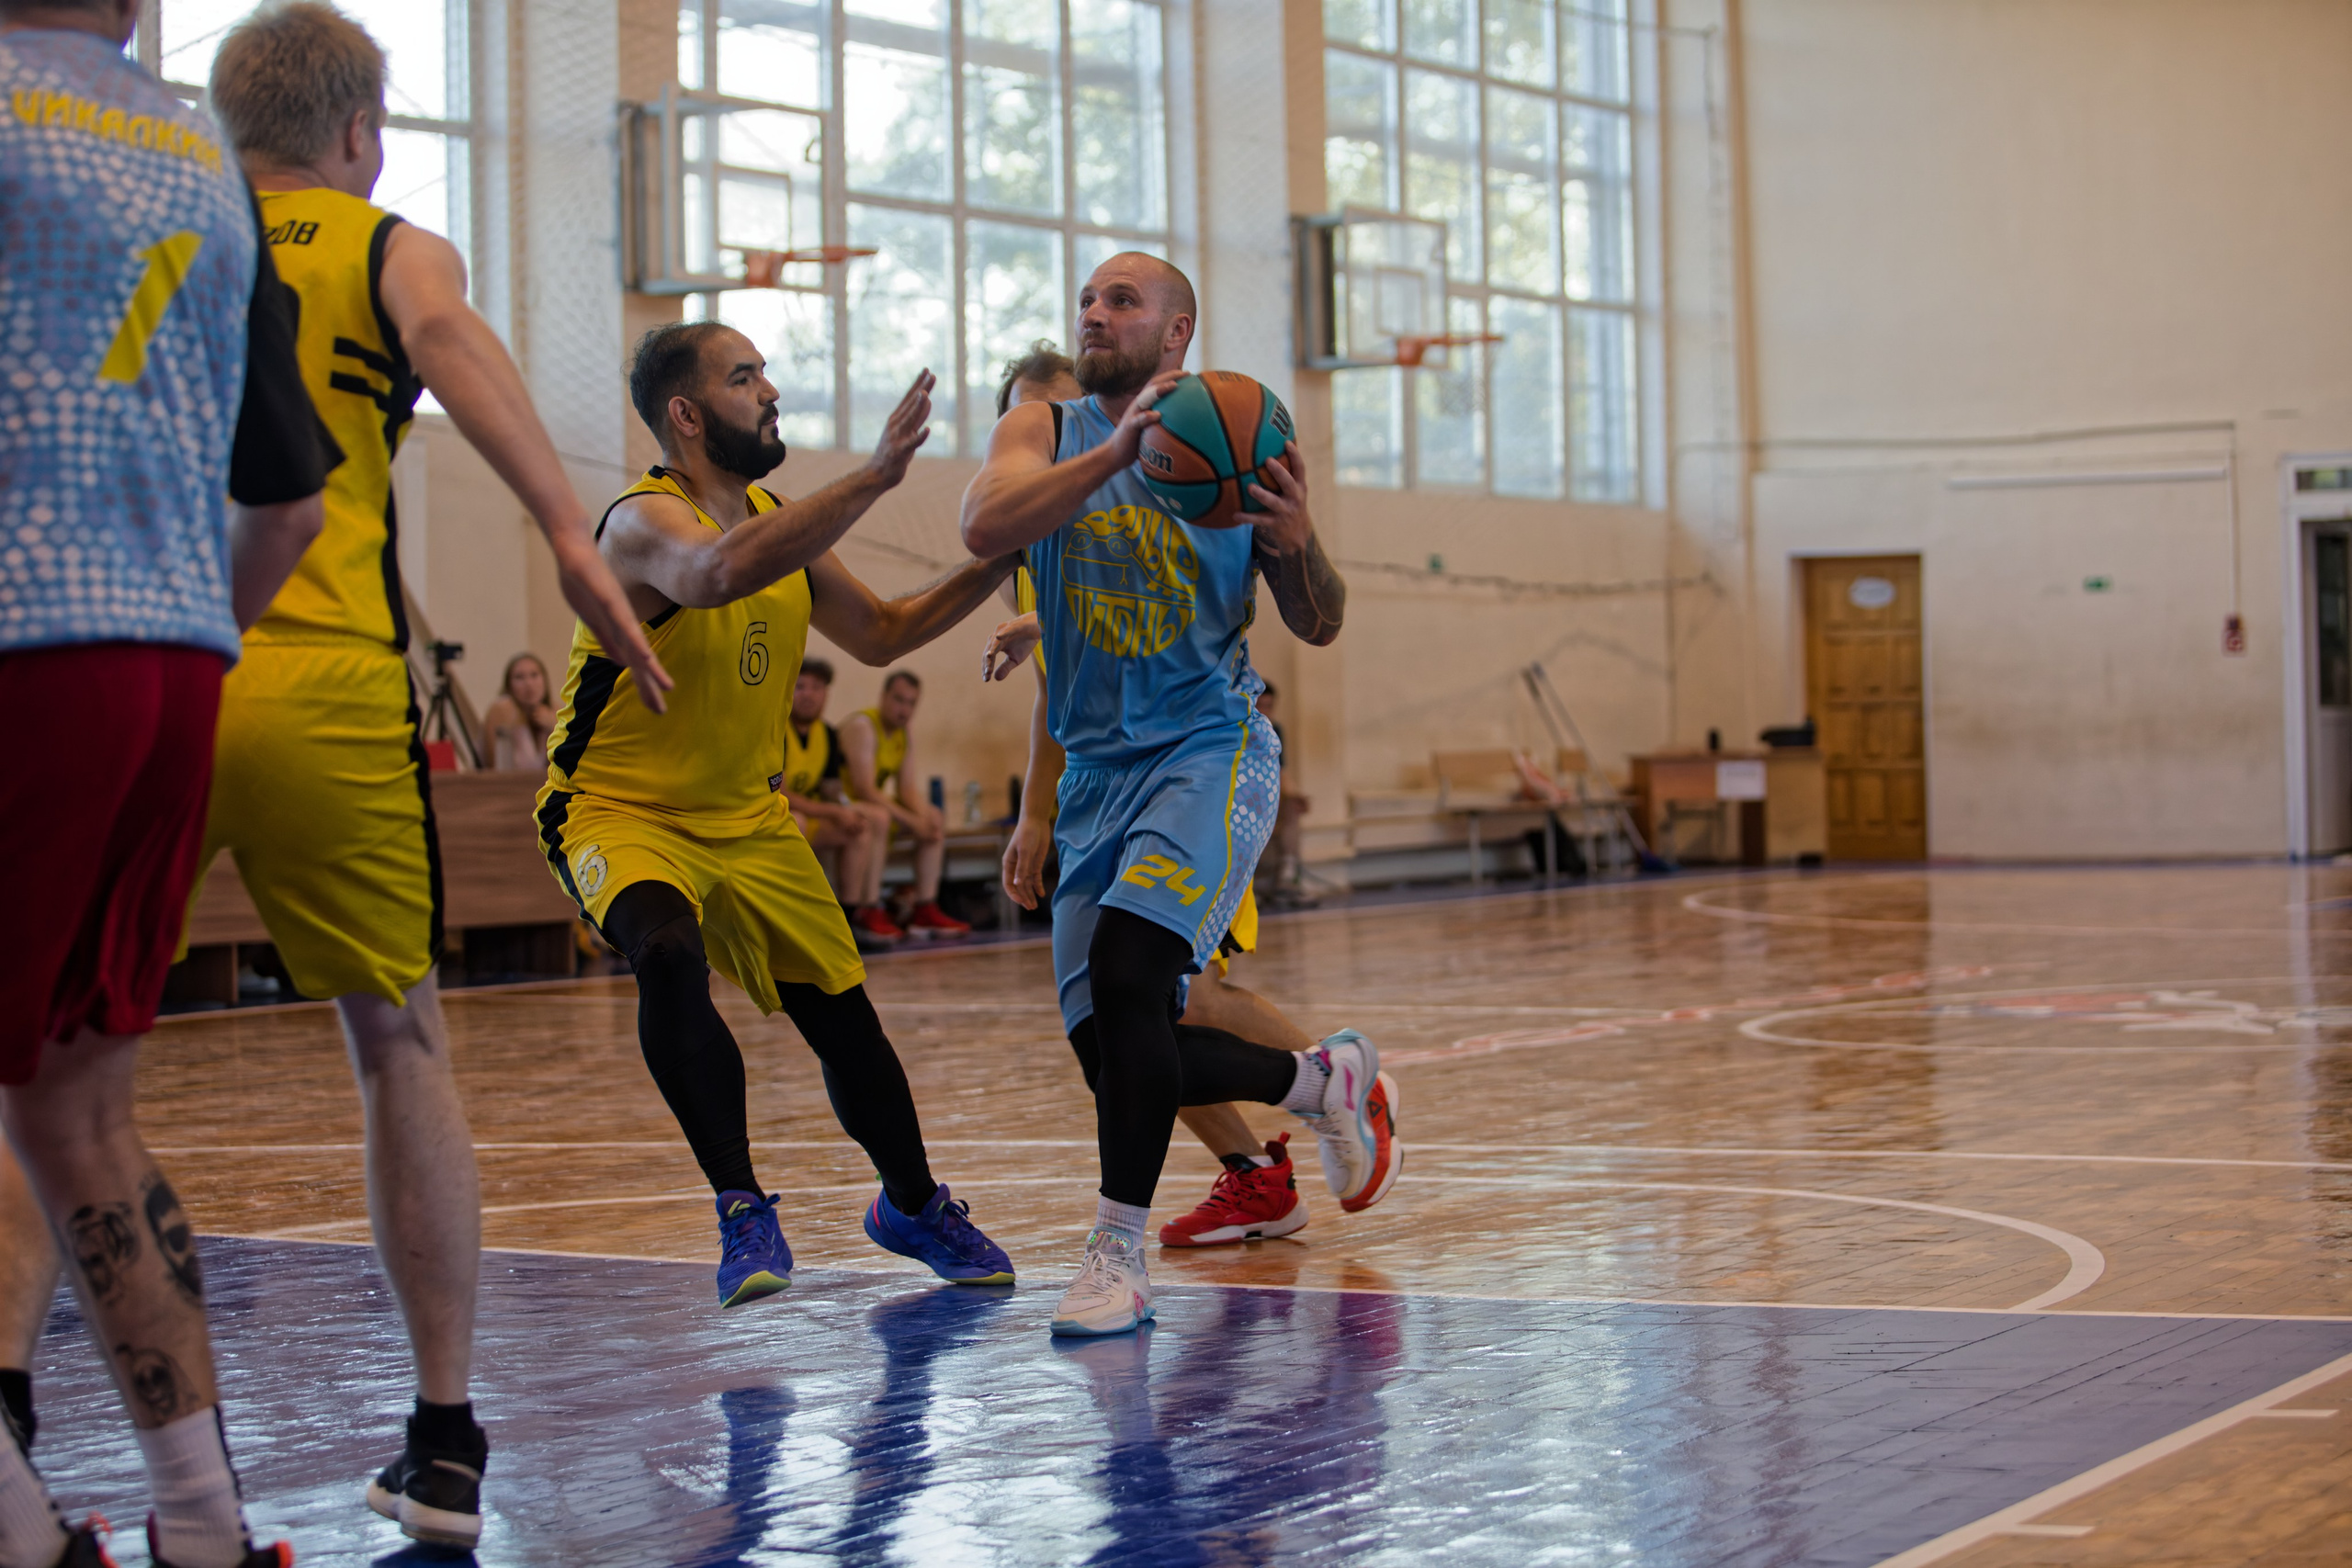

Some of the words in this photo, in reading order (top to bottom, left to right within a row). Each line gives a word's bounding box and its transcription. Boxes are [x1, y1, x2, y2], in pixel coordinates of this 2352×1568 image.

[1064, 585, 1195, 659] ПИТОНЫ
[740, 621, 769, 686] 6
[577, 844, 608, 897] 6
[1120, 853, 1206, 907] 24
